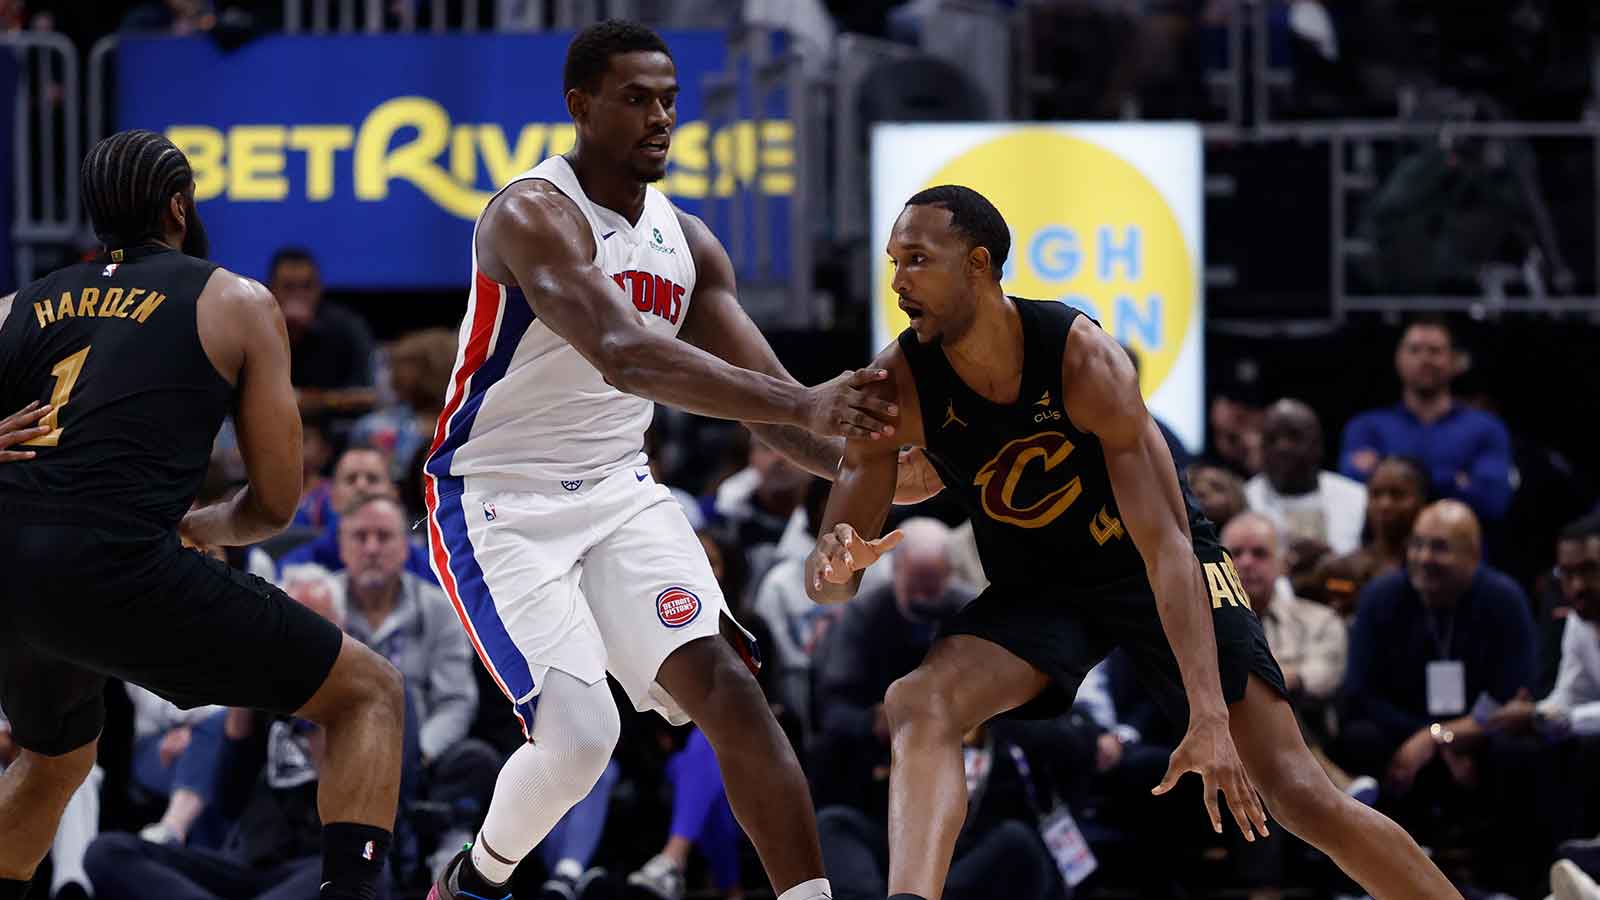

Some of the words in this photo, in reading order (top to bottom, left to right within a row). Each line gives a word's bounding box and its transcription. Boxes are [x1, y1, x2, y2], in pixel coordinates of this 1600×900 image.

[33, 287, 167, 329] HARDEN
[19, 345, 92, 447] 1
[973, 430, 1083, 529] C
[1089, 504, 1125, 546] 4
